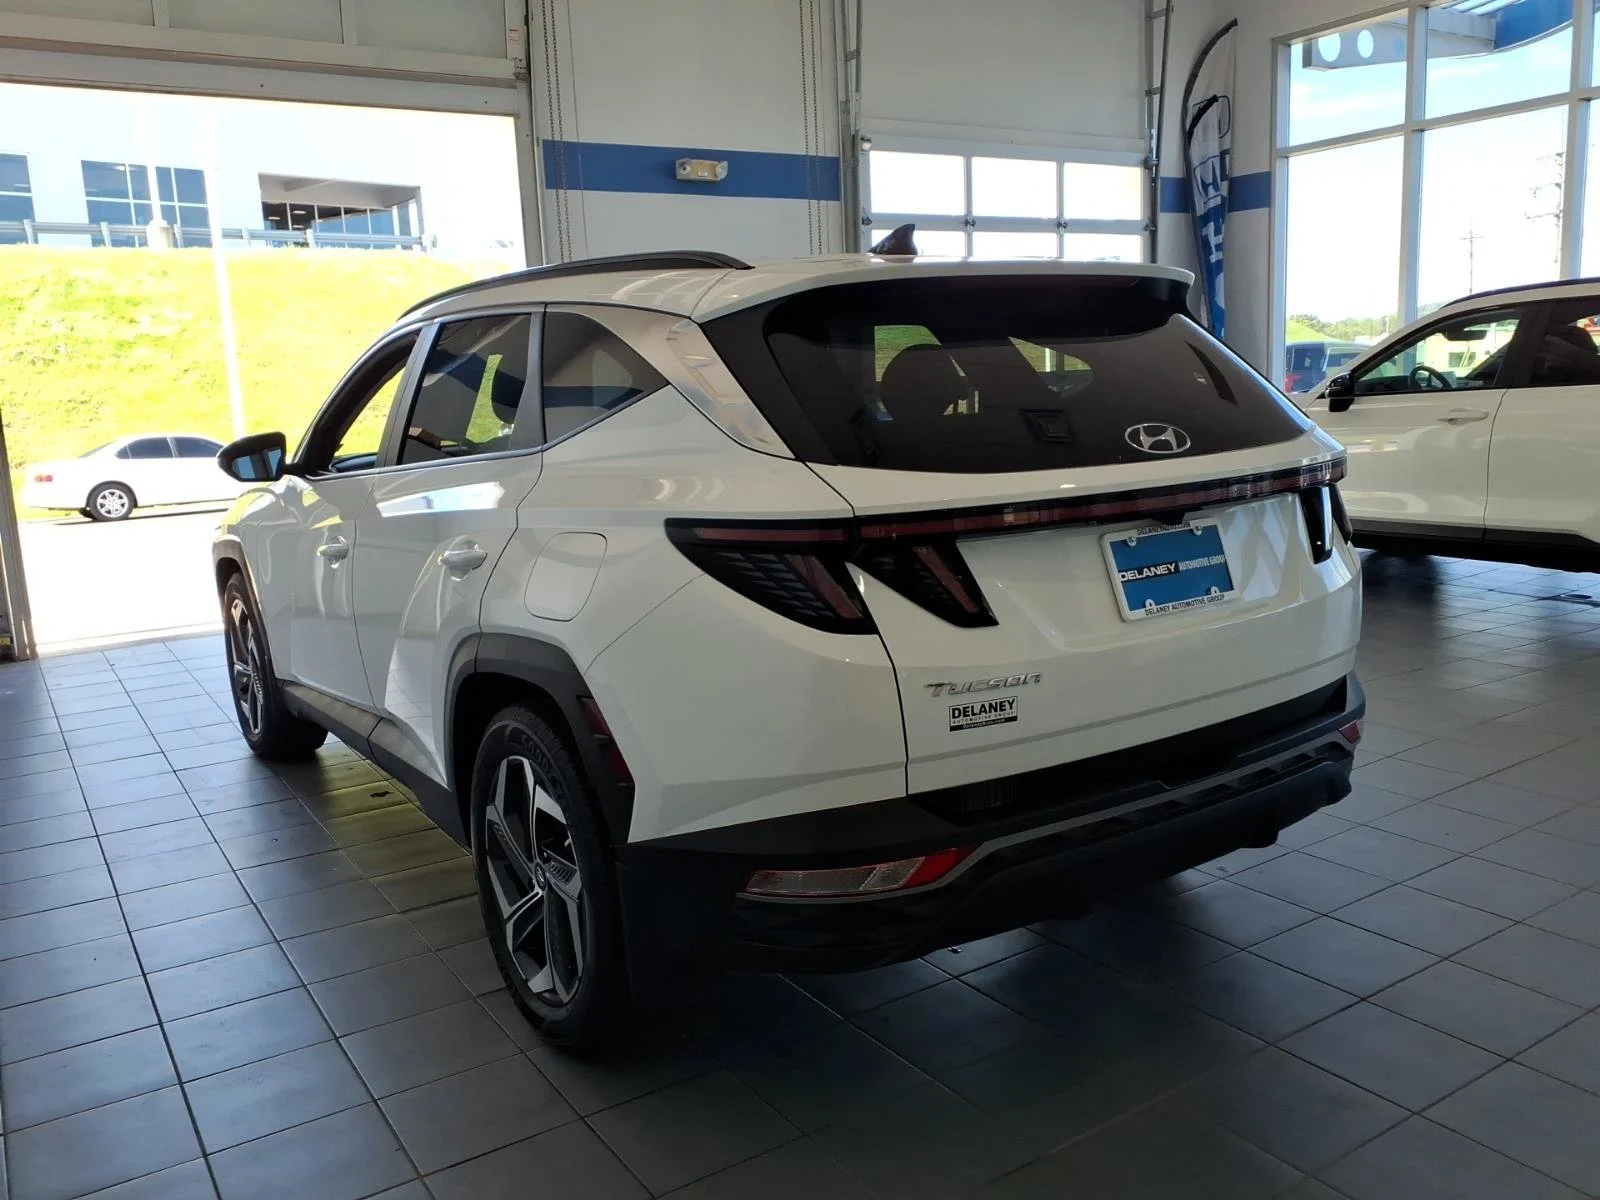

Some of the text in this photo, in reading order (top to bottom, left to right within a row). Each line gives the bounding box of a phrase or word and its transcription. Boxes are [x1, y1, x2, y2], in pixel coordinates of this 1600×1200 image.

[1120, 563, 1176, 582] DELANEY
[1178, 556, 1210, 572] AUTOMOTIVE
[1144, 593, 1225, 616] DELANEY AUTOMOTIVE GROUP
[924, 672, 1042, 698] TUCSON
[951, 698, 1016, 720] DELANEY
